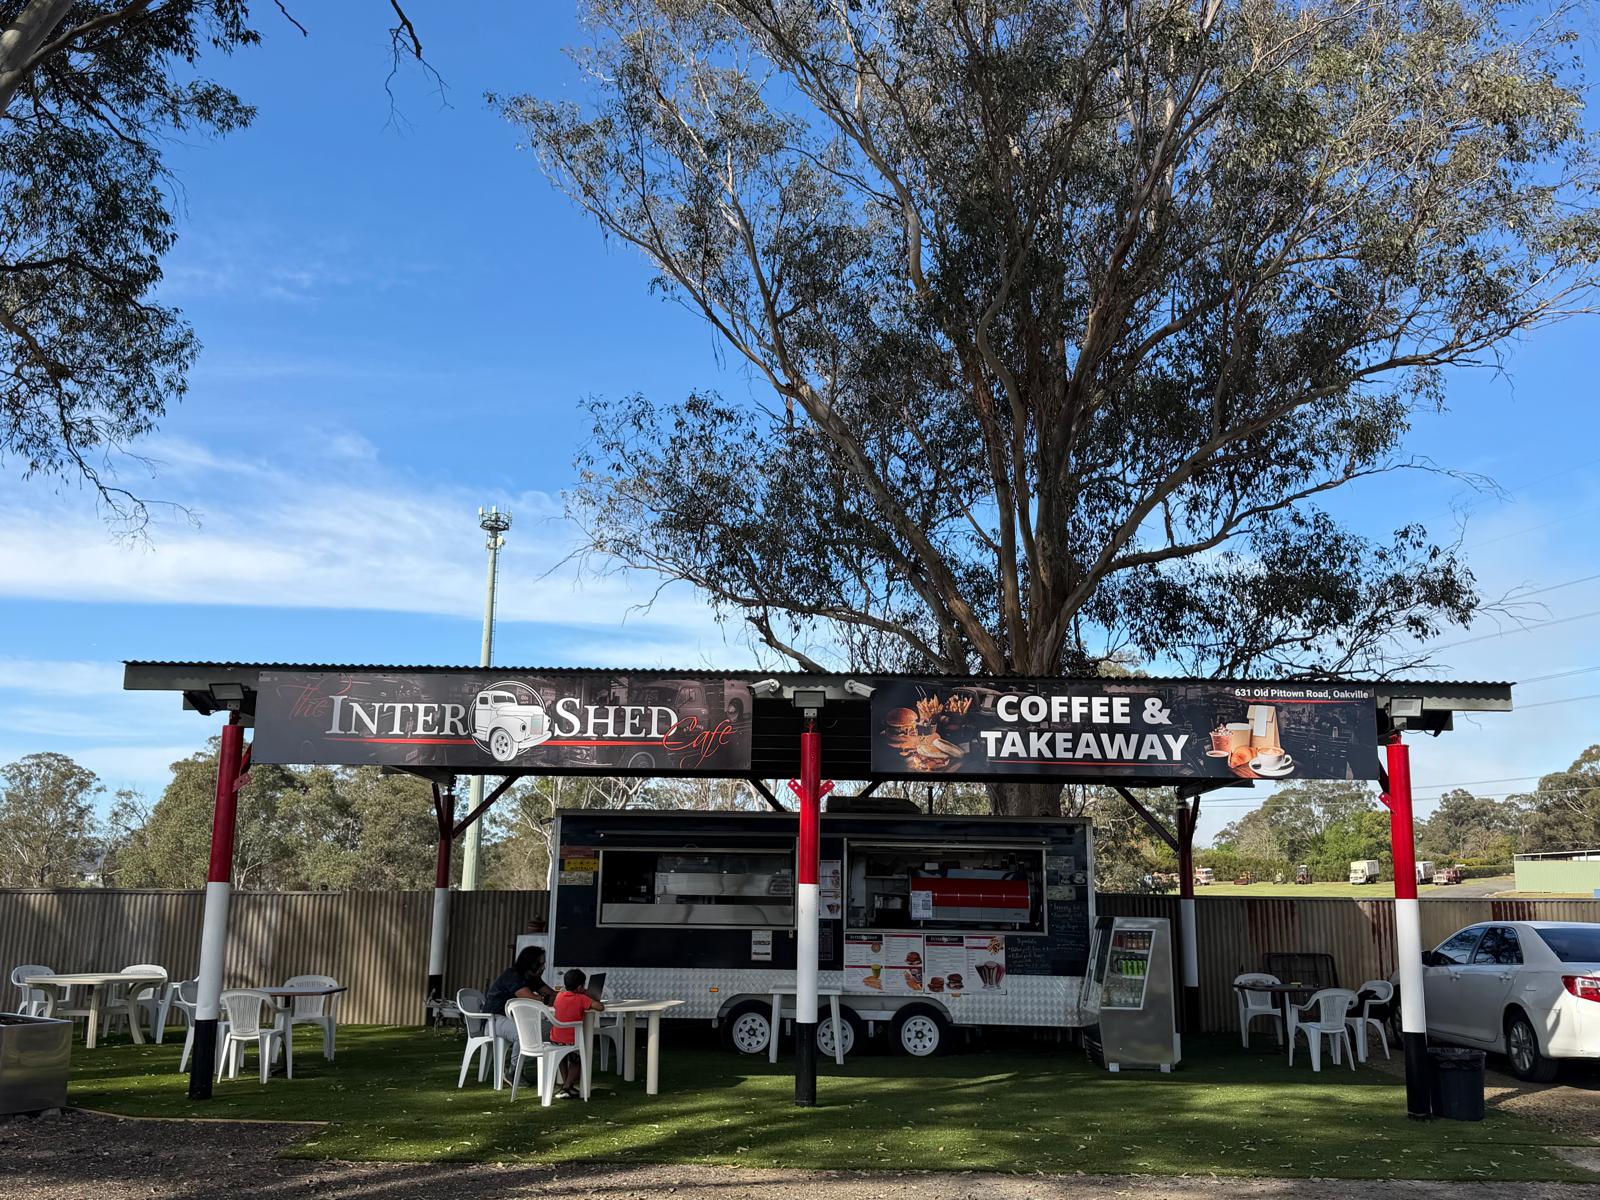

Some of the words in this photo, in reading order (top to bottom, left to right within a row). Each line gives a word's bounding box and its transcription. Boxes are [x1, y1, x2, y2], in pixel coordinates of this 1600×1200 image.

[1234, 688, 1252, 697] 631
[1253, 688, 1269, 697] Old
[1271, 688, 1304, 698] Pittown
[1306, 689, 1331, 699] Road,
[1333, 689, 1369, 698] Oakville
[325, 694, 470, 736] INTER
[554, 697, 679, 739] SHED
[997, 695, 1131, 724] COFFEE
[1142, 697, 1173, 725] &
[980, 731, 1190, 761] TAKEAWAY
